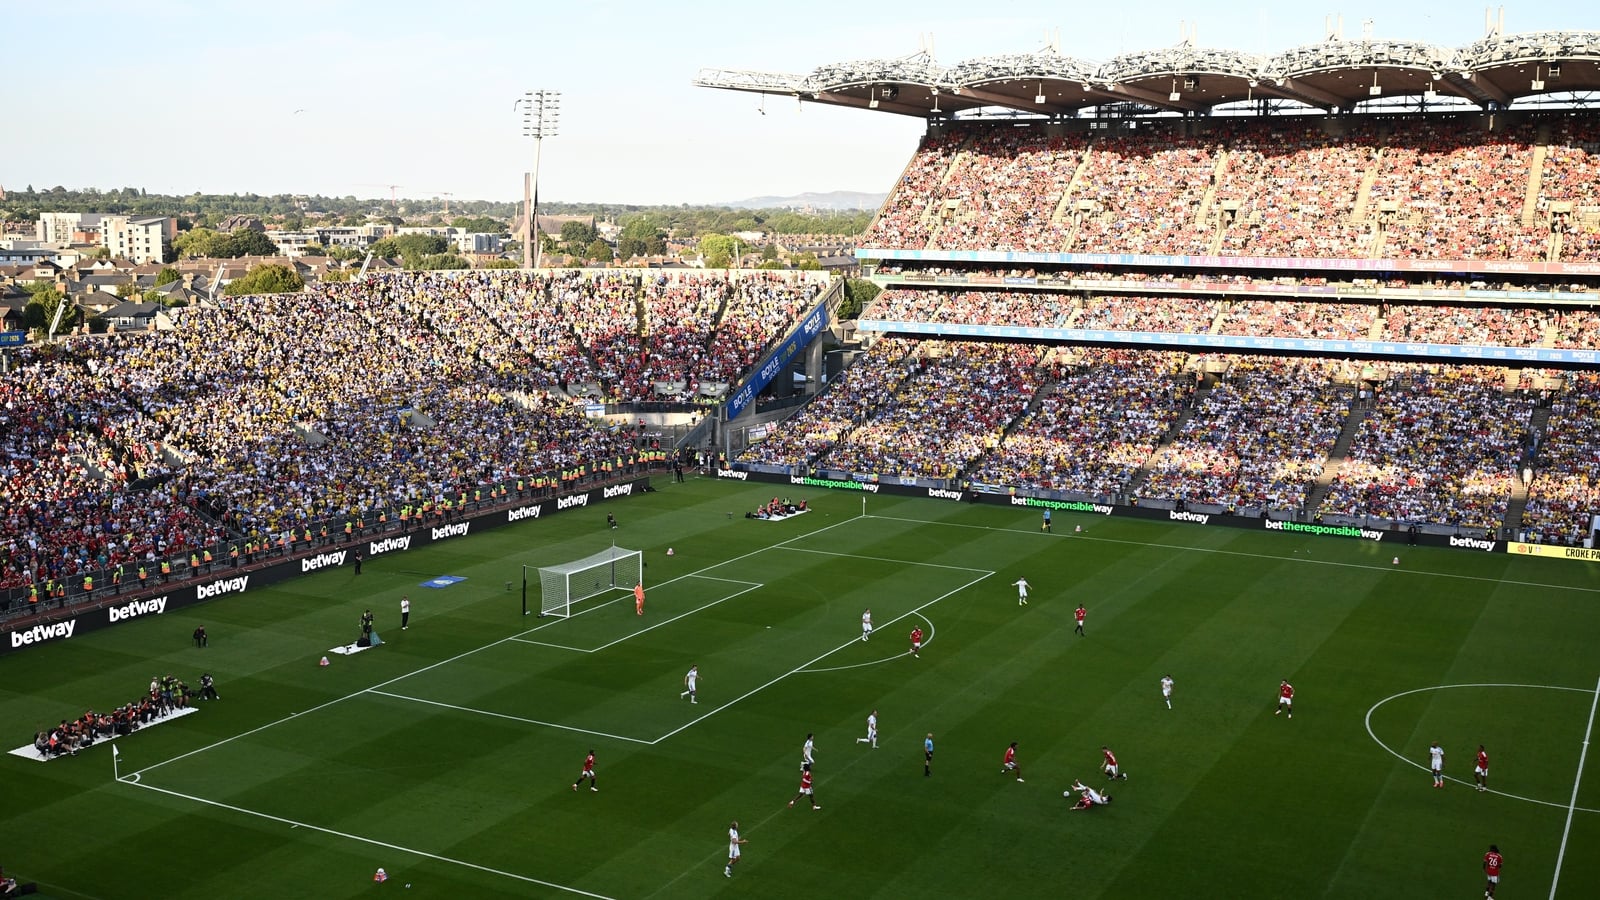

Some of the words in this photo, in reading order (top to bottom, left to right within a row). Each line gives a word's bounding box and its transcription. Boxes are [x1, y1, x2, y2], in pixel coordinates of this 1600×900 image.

[1072, 254, 1106, 263] Allianz
[1133, 256, 1168, 265] Allianz
[1237, 257, 1254, 265] AIB
[1270, 258, 1288, 267] AIB
[1304, 259, 1322, 268] AIB
[1339, 260, 1357, 269] AIB
[1374, 260, 1393, 269] AIB
[1410, 261, 1453, 270] SuperValu
[1484, 262, 1529, 271] SuperValu
[804, 311, 821, 334] BOYLE
[1572, 351, 1595, 359] BOYLE
[761, 356, 779, 380] BOYLE
[733, 385, 752, 409] BOYLE
[718, 468, 748, 481] betway
[604, 483, 633, 498] betway
[791, 475, 879, 493] bettheresponsibleway
[558, 493, 588, 509] betway
[928, 487, 962, 501] betway
[1011, 496, 1113, 515] bettheresponsibleway
[508, 505, 541, 522] betway
[1169, 510, 1209, 525] betway
[432, 522, 470, 540] betway
[1265, 519, 1384, 541] bettheresponsibleway
[370, 536, 411, 555] betway
[1450, 535, 1496, 552] betway
[1528, 546, 1533, 554] V
[301, 550, 347, 572] betway
[1565, 548, 1589, 559] CROKE
[197, 576, 249, 599] betway
[109, 596, 167, 622] betway
[11, 620, 76, 648] betway
[1488, 857, 1498, 867] 26
